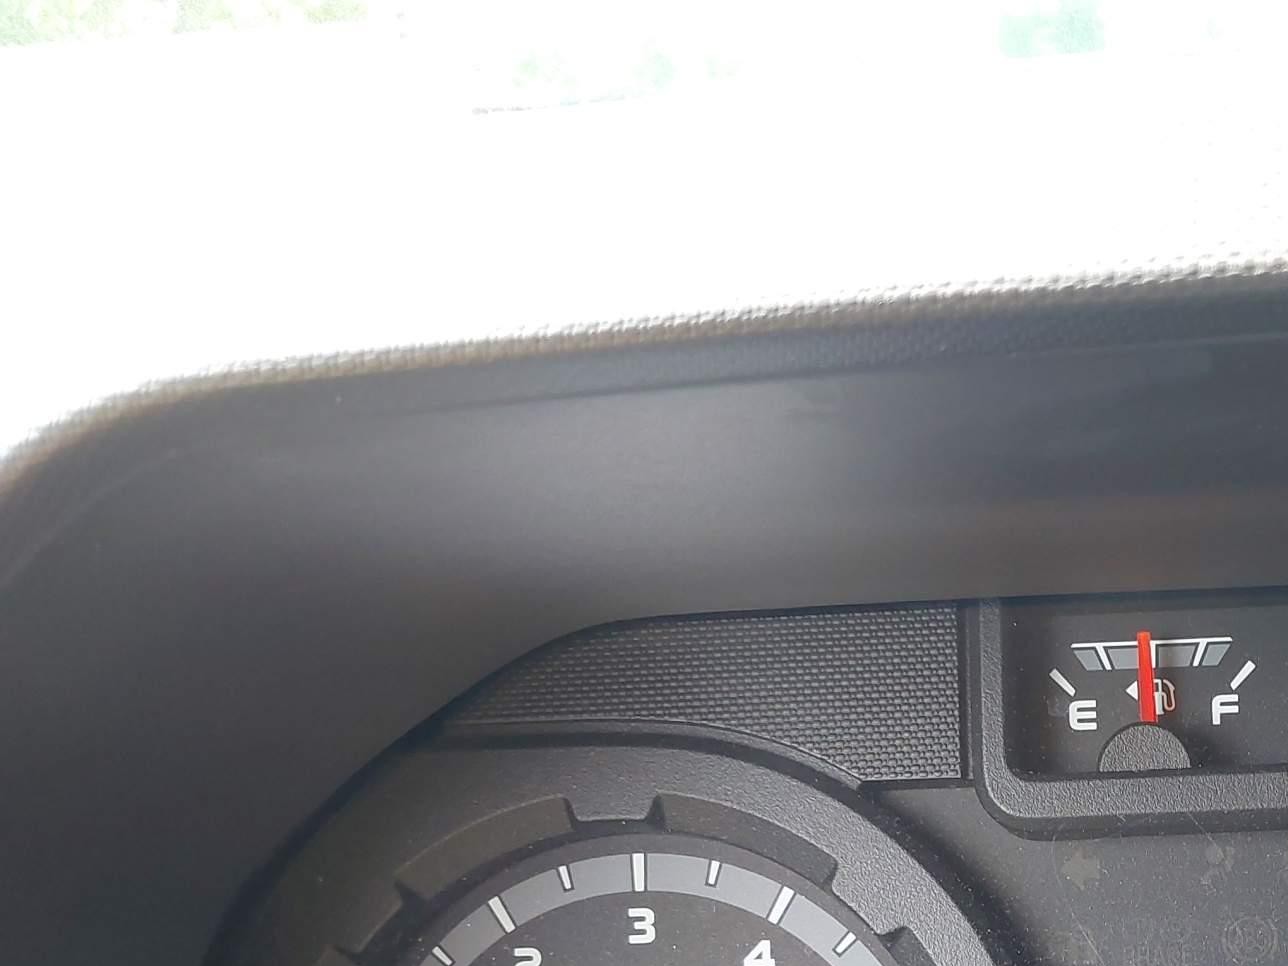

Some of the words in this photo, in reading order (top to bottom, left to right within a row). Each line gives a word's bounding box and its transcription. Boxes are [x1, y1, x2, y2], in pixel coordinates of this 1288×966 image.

[1068, 699, 1098, 731] E
[1211, 694, 1239, 725] F
[627, 907, 656, 944] 3
